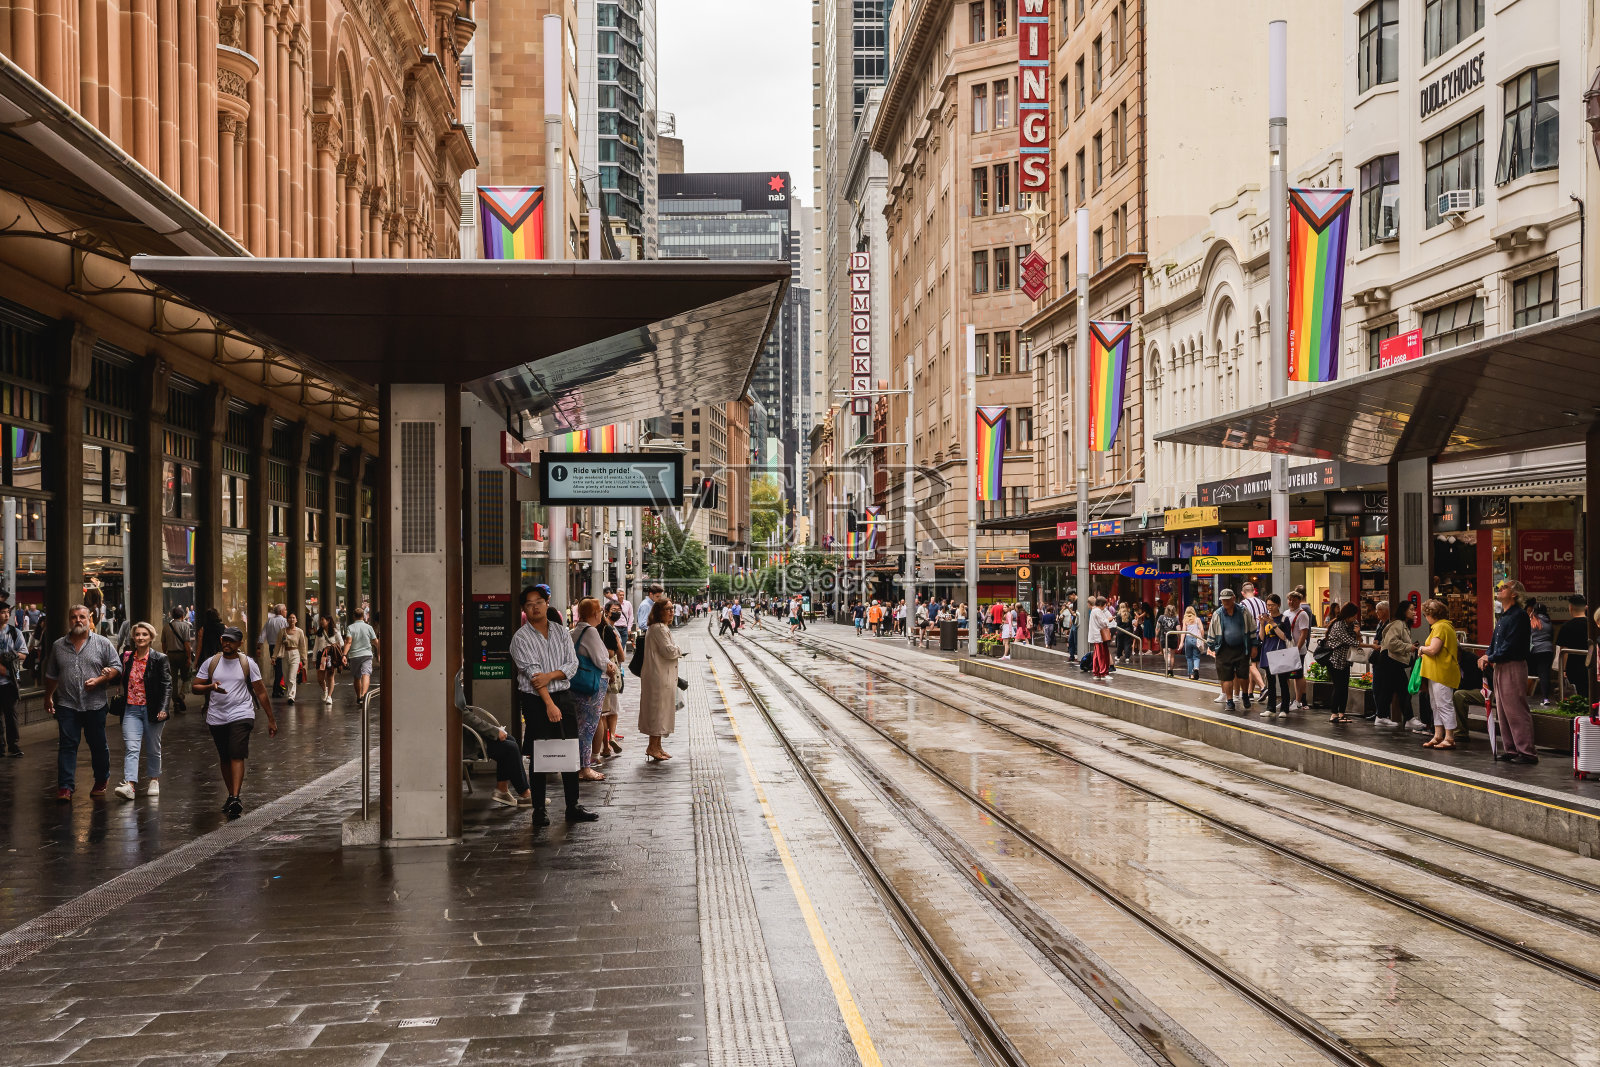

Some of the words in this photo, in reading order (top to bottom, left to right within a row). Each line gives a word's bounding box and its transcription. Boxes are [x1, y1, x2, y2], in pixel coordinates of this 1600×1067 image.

[768, 193, 785, 202] nab
[853, 254, 870, 394] DYMOCKS
[1381, 357, 1390, 368] For
[1391, 353, 1407, 366] Lease
[608, 467, 630, 476] pride!
[1243, 479, 1272, 494] DOWNTOW
[1288, 471, 1318, 488] UVENIRS
[1305, 542, 1340, 555] SOUVENIRS
[1523, 548, 1550, 562] For
[1090, 562, 1120, 571] Kidstuff
[1210, 559, 1237, 567] Simmons
[1144, 567, 1159, 576] Ezy
